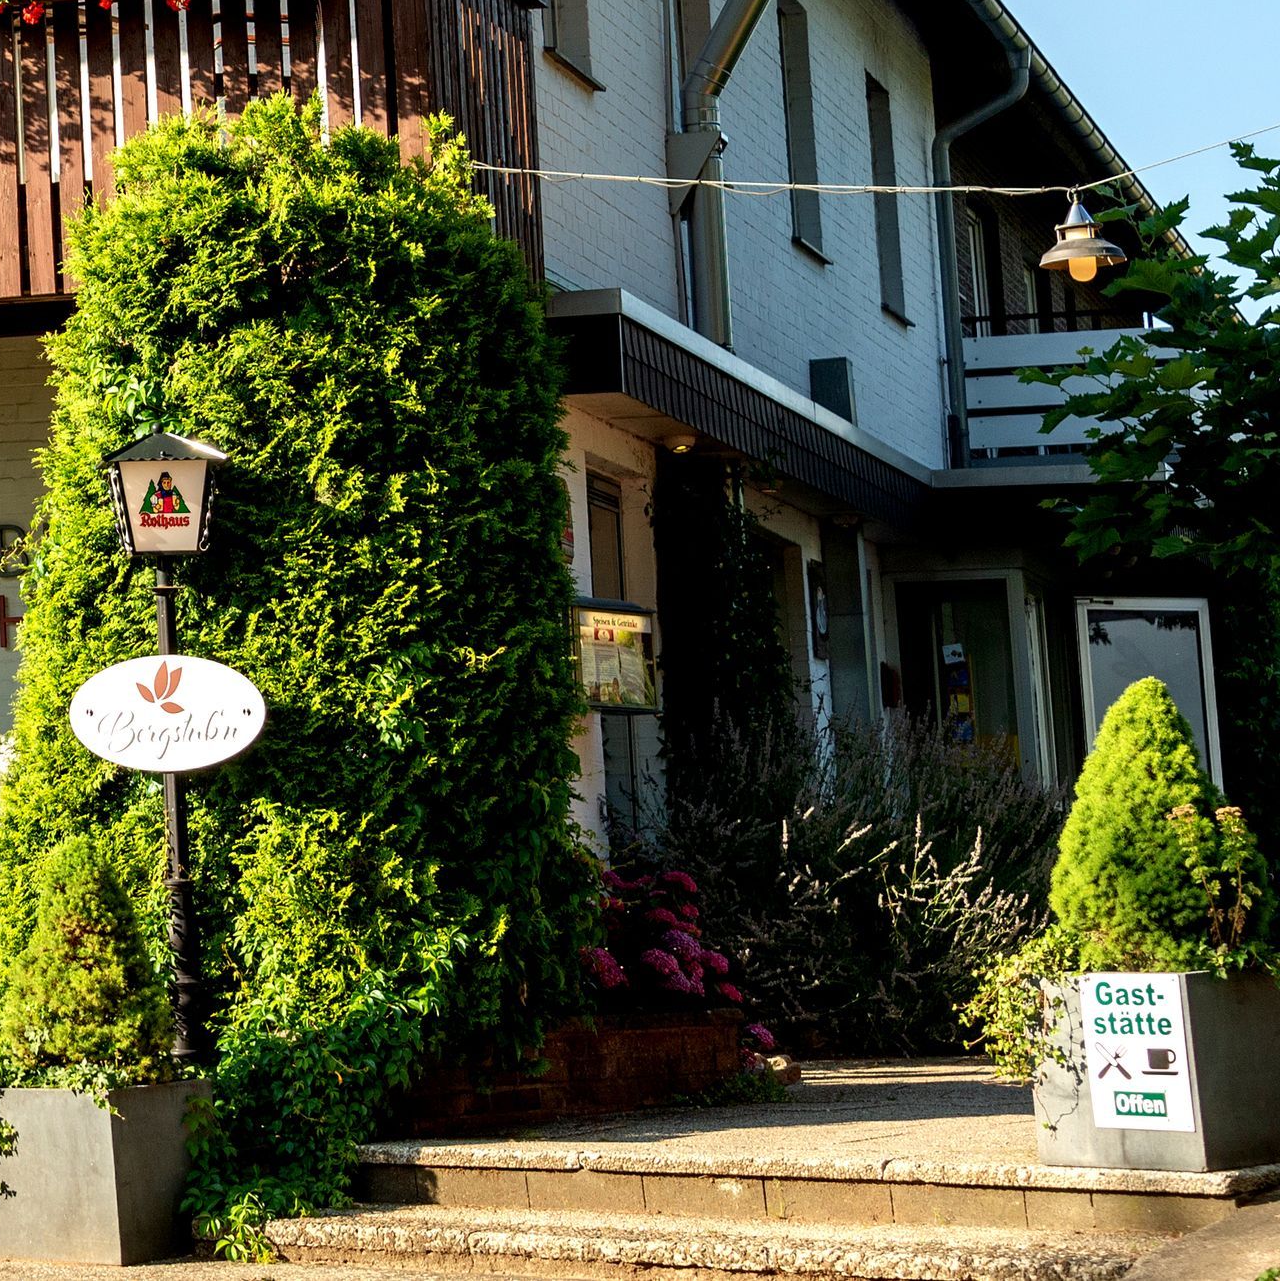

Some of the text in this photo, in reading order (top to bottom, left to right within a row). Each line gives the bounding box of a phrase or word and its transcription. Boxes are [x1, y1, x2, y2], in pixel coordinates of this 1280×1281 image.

[139, 512, 190, 529] Rothaus
[1095, 981, 1165, 1006] Gast-
[1094, 1011, 1172, 1035] stätte
[1115, 1092, 1166, 1115] Offen
